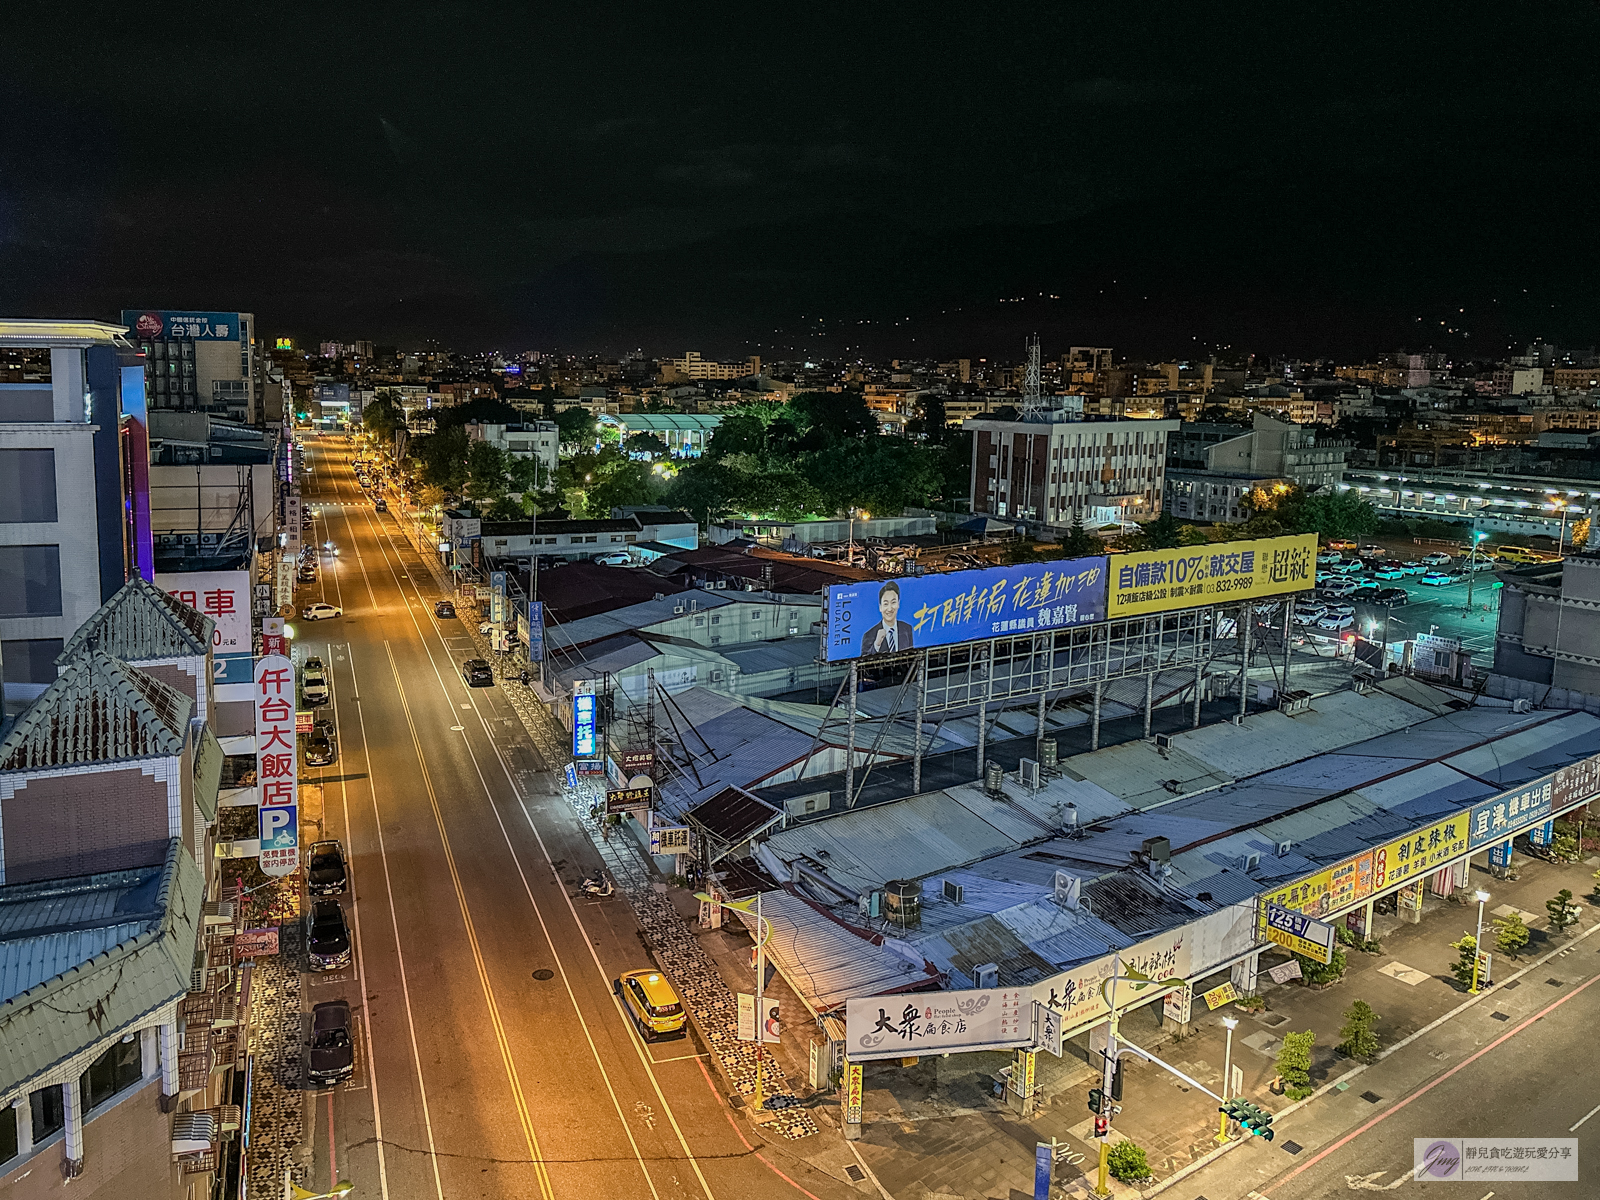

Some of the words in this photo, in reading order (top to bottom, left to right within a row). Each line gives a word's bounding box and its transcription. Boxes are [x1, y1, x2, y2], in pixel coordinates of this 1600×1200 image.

[171, 324, 229, 338] 台灣人壽
[913, 579, 1008, 636] 打開新局
[1012, 565, 1101, 611] 花蓮加油
[834, 601, 842, 647] HUALIEN
[841, 600, 851, 645] LOVE
[991, 616, 1035, 633] 花蓮縣議員
[1037, 603, 1078, 628] 魏嘉賢
[258, 668, 293, 806] 仟台大飯店
[262, 809, 290, 841] P
[1476, 803, 1506, 836] 宜津
[1508, 782, 1552, 817] 機車出租
[1269, 908, 1294, 928] 125
[1271, 928, 1293, 948] 200
[933, 1007, 956, 1016] People
